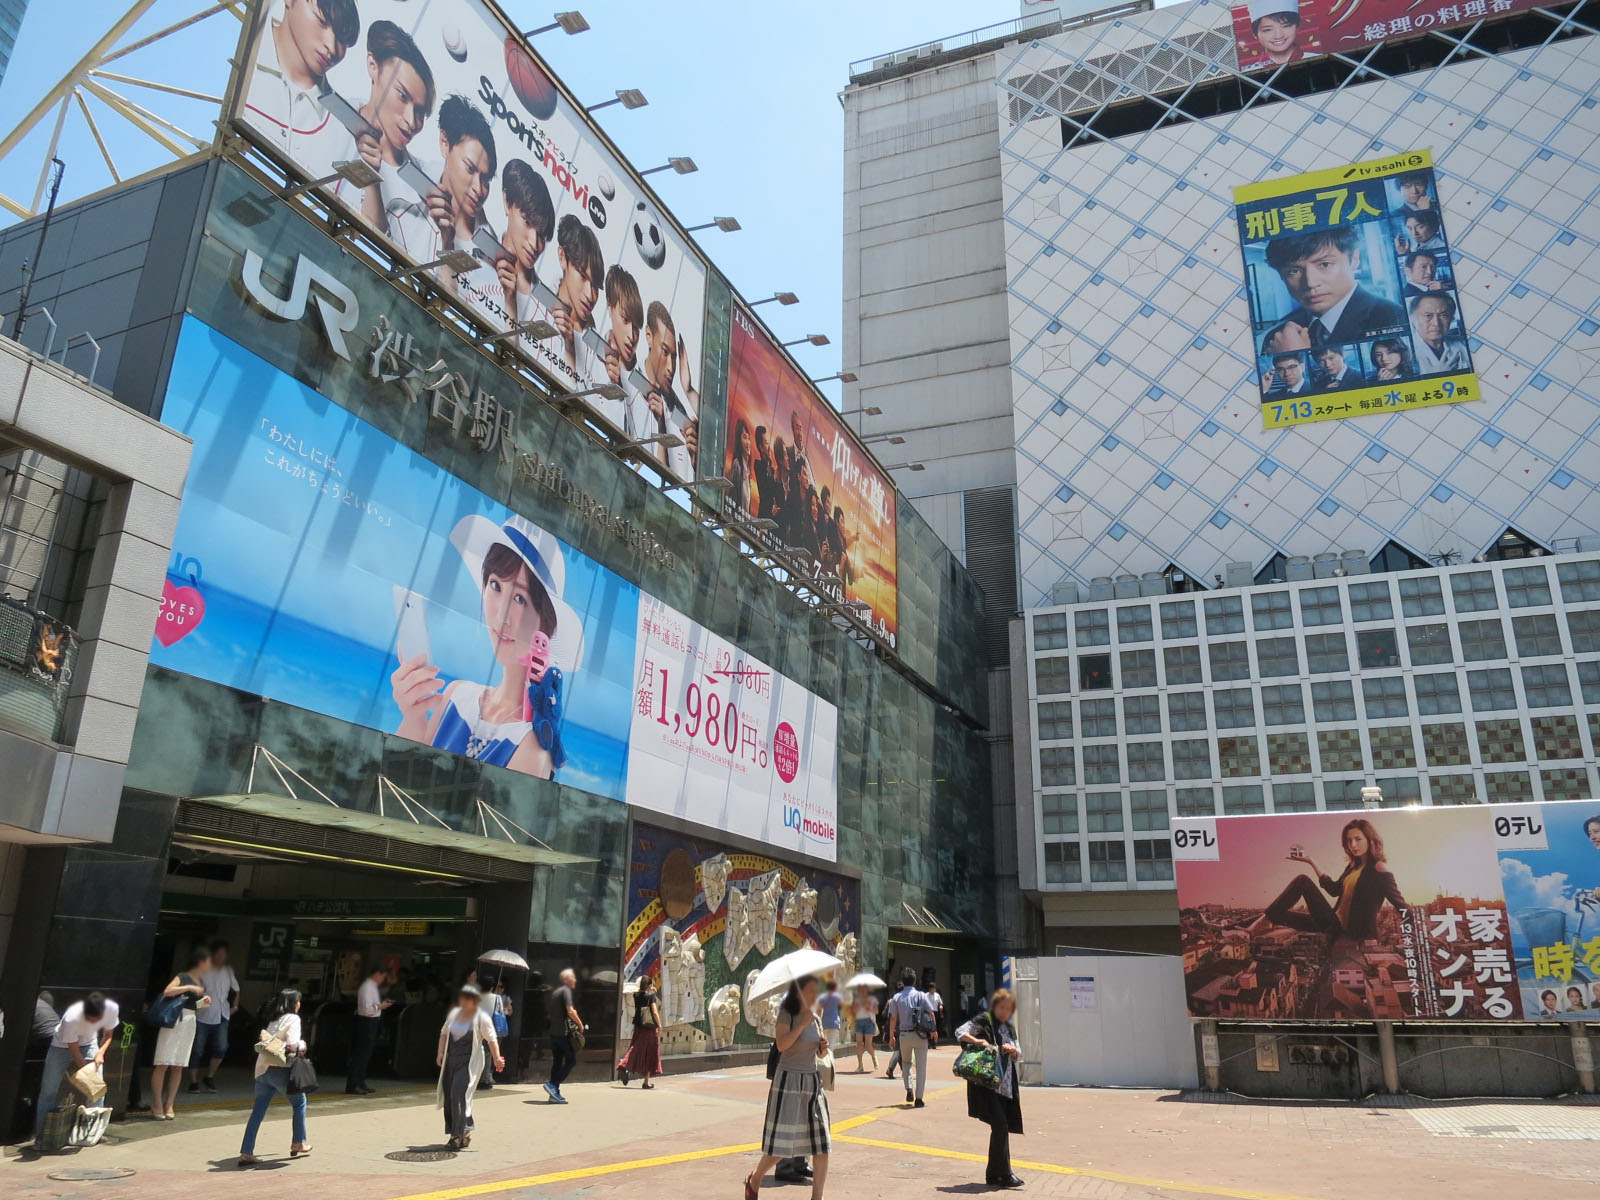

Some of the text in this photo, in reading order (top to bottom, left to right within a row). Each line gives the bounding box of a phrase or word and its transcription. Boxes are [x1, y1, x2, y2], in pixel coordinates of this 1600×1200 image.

[1360, 166, 1372, 175] tv
[1375, 159, 1406, 173] asahi
[1246, 188, 1382, 240] 刑事7人
[242, 249, 359, 362] JR
[733, 306, 755, 338] TBS
[369, 314, 515, 464] 渋谷駅
[1359, 389, 1418, 409] 毎週水曜
[1421, 381, 1470, 402] よる9時
[520, 452, 611, 527] Shibuya
[157, 609, 185, 625] YOU
[158, 596, 195, 616] OVES
[637, 658, 655, 720] 月額
[783, 805, 834, 841] UQ mobile
[258, 927, 288, 947] JR
[1429, 907, 1475, 1018] オンナ
[1466, 907, 1514, 1019] 家売る
